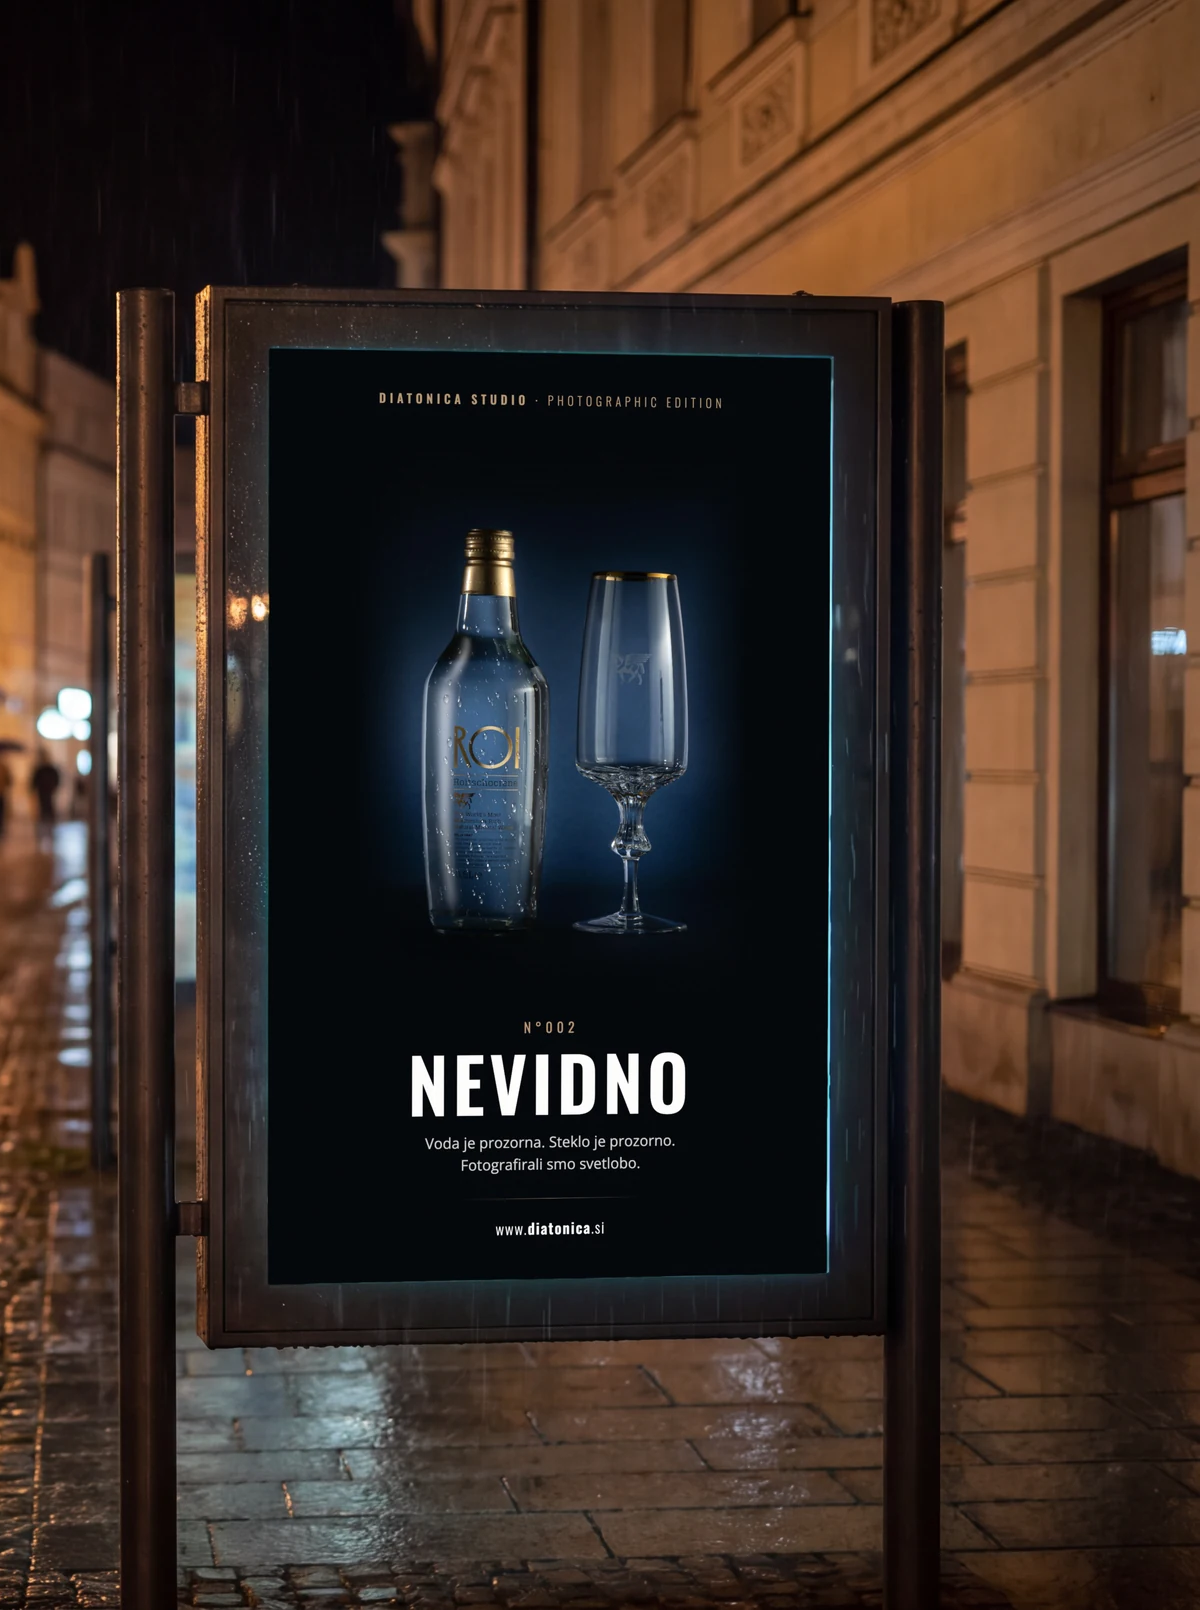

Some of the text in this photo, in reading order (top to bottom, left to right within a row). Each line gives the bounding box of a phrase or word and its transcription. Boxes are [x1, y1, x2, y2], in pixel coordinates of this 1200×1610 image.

[378, 392, 722, 409] DIATONICA STUDIO PHOTOGRAPHIC EDITION
[454, 725, 520, 770] ROI
[523, 1020, 575, 1034] N°002
[411, 1052, 686, 1117] NEVIDNO
[424, 1134, 676, 1153] Voda je prozorna. Steklo je prozorno.
[461, 1156, 641, 1175] Fotografirali smo svetlobo.
[495, 1221, 605, 1237] www.diatonica.si
